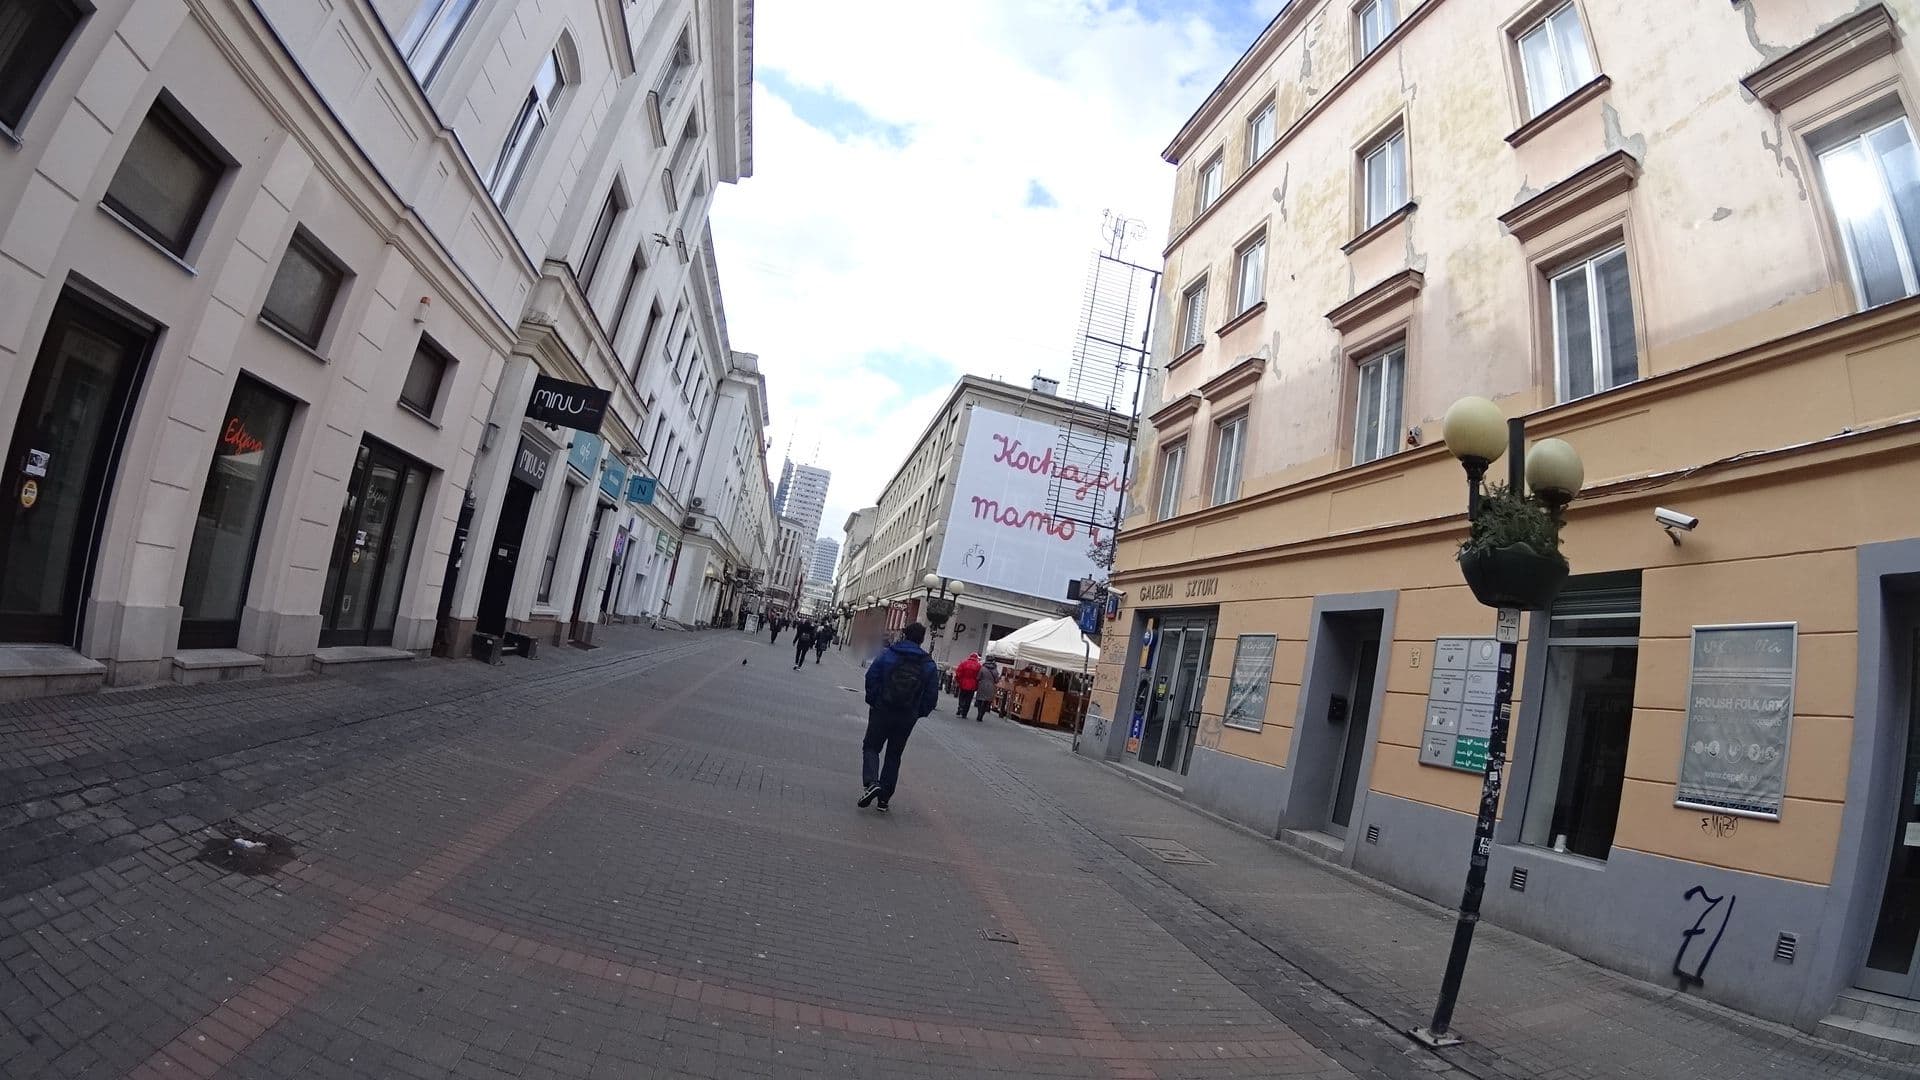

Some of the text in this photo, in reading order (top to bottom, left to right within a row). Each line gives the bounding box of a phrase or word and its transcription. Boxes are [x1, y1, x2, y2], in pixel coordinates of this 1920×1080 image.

[971, 495, 1076, 541] mamo
[1139, 577, 1219, 602] GALERIA SZTUKI
[1700, 697, 1733, 709] POLISH
[1734, 698, 1759, 711] FOLK
